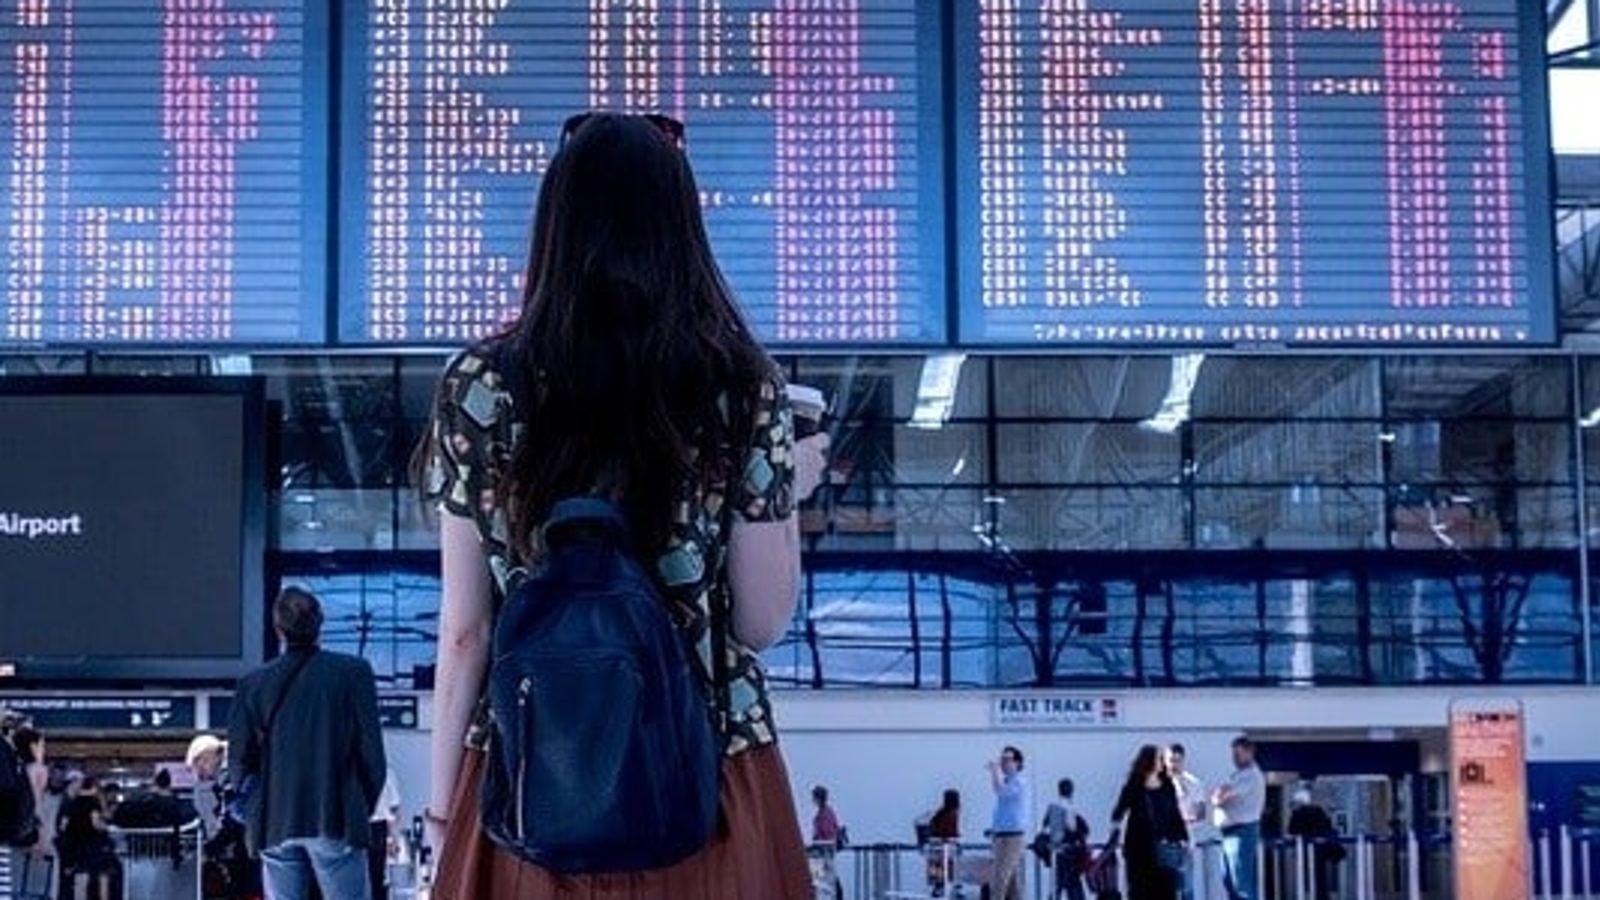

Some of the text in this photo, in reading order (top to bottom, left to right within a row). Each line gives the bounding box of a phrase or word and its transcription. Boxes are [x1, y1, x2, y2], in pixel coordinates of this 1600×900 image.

[0, 512, 81, 539] Airport
[1000, 698, 1038, 713] FAST
[1044, 698, 1093, 713] TRACK
